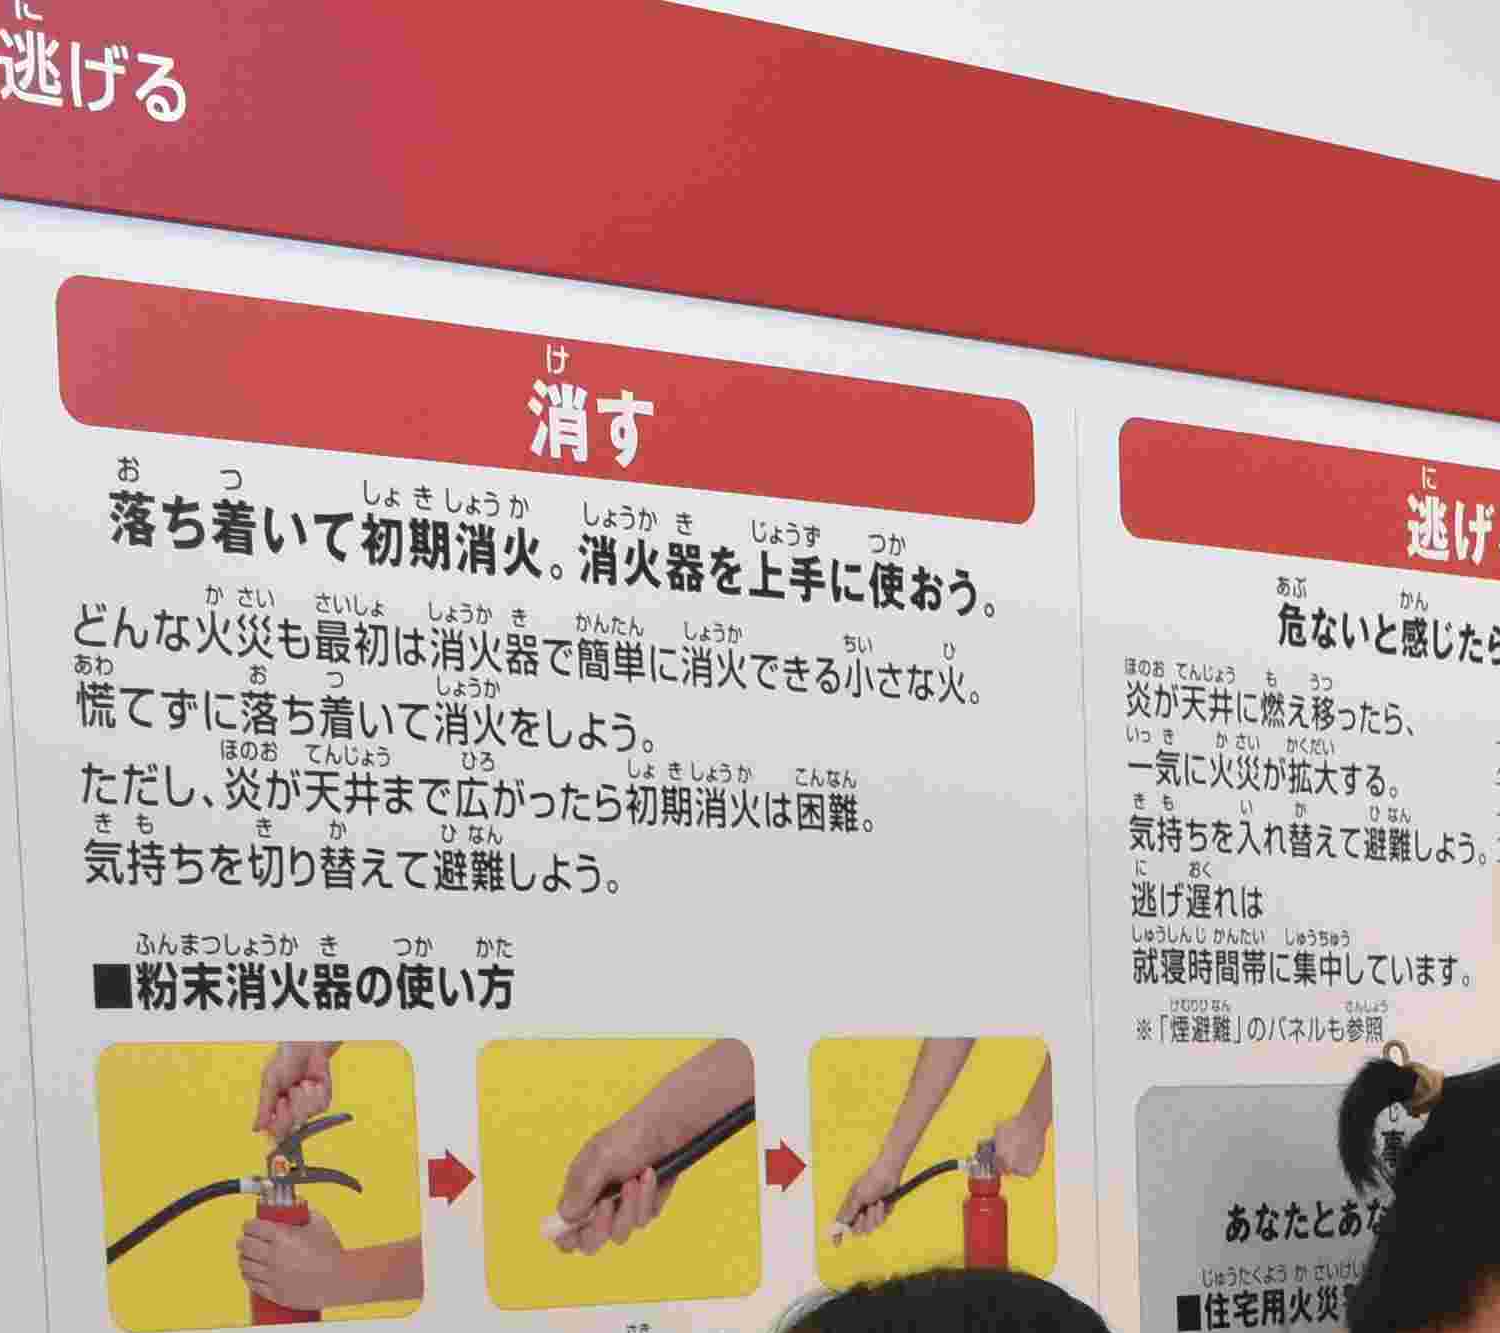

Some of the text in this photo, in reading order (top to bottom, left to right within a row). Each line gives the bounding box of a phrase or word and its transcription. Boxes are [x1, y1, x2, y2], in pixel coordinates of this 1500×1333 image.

[526, 379, 655, 469] 消す
[108, 489, 996, 619] 落ち着いて初期消火。消火器を上手に使おう。
[750, 519, 907, 557] じょうず つか
[1276, 576, 1429, 612] あぶ かん
[315, 593, 874, 654] さいしょ かんたん しょうか ちい
[72, 602, 980, 705] どんな火災も最初は消火器で簡単に消火できる小さな火。
[73, 655, 501, 700] あわ しょうか
[1123, 657, 1333, 691] ほのお てんじょう うつ
[74, 681, 654, 753] 慌てずに落ち着いて消火をしよう。
[1125, 678, 1416, 738] 炎が天井に燃え移ったら、
[220, 740, 858, 790] ほのお てんじょう ひろ こんなん
[1286, 736, 1336, 756] かくだい
[80, 762, 874, 833] ただし、炎が天井まで広がったら初期消火は困難。
[1126, 748, 1398, 800] 一気に火災が拡大する。
[1128, 815, 1488, 866] 気持ちを入れ替えて避難しよう。
[83, 840, 619, 895] 気持ちを切り替えて避難しよう。
[1188, 861, 1213, 879] おく
[1131, 882, 1263, 919] 逃げ遅れは
[393, 935, 434, 958] つか
[475, 937, 515, 959] かた
[1132, 947, 1471, 988] 就寝時間帯に集中しています。
[135, 962, 515, 1011] 粉末消火器の使い方
[1135, 1014, 1385, 1044] ※「煙避難」のパネルも参照
[1204, 1285, 1350, 1331] 住宅用火災
